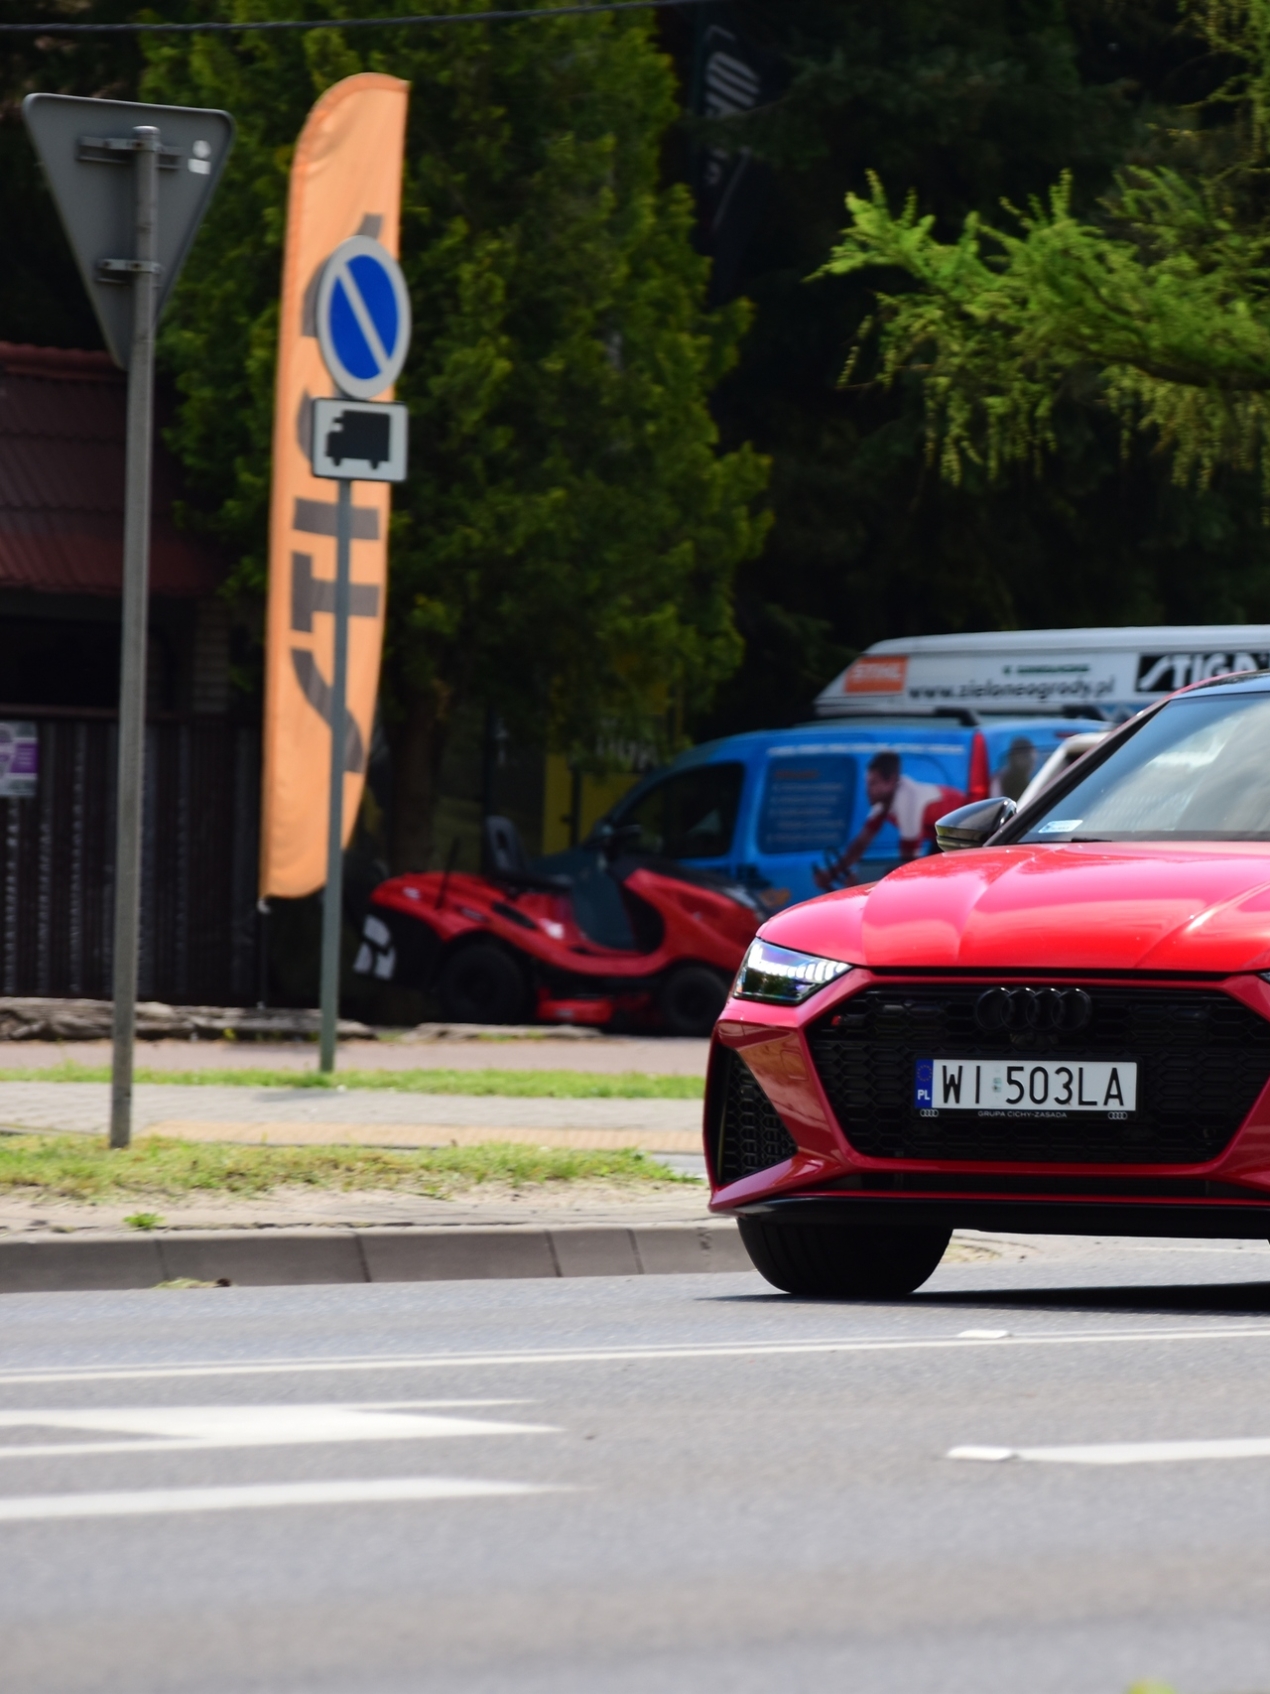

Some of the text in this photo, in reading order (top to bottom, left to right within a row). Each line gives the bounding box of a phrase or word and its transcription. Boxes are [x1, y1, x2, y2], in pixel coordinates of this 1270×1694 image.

[909, 674, 1115, 699] www.zieloneogrody.pl
[1140, 651, 1258, 690] STIGA
[917, 1089, 930, 1100] PL
[942, 1065, 1124, 1106] WI 503LA
